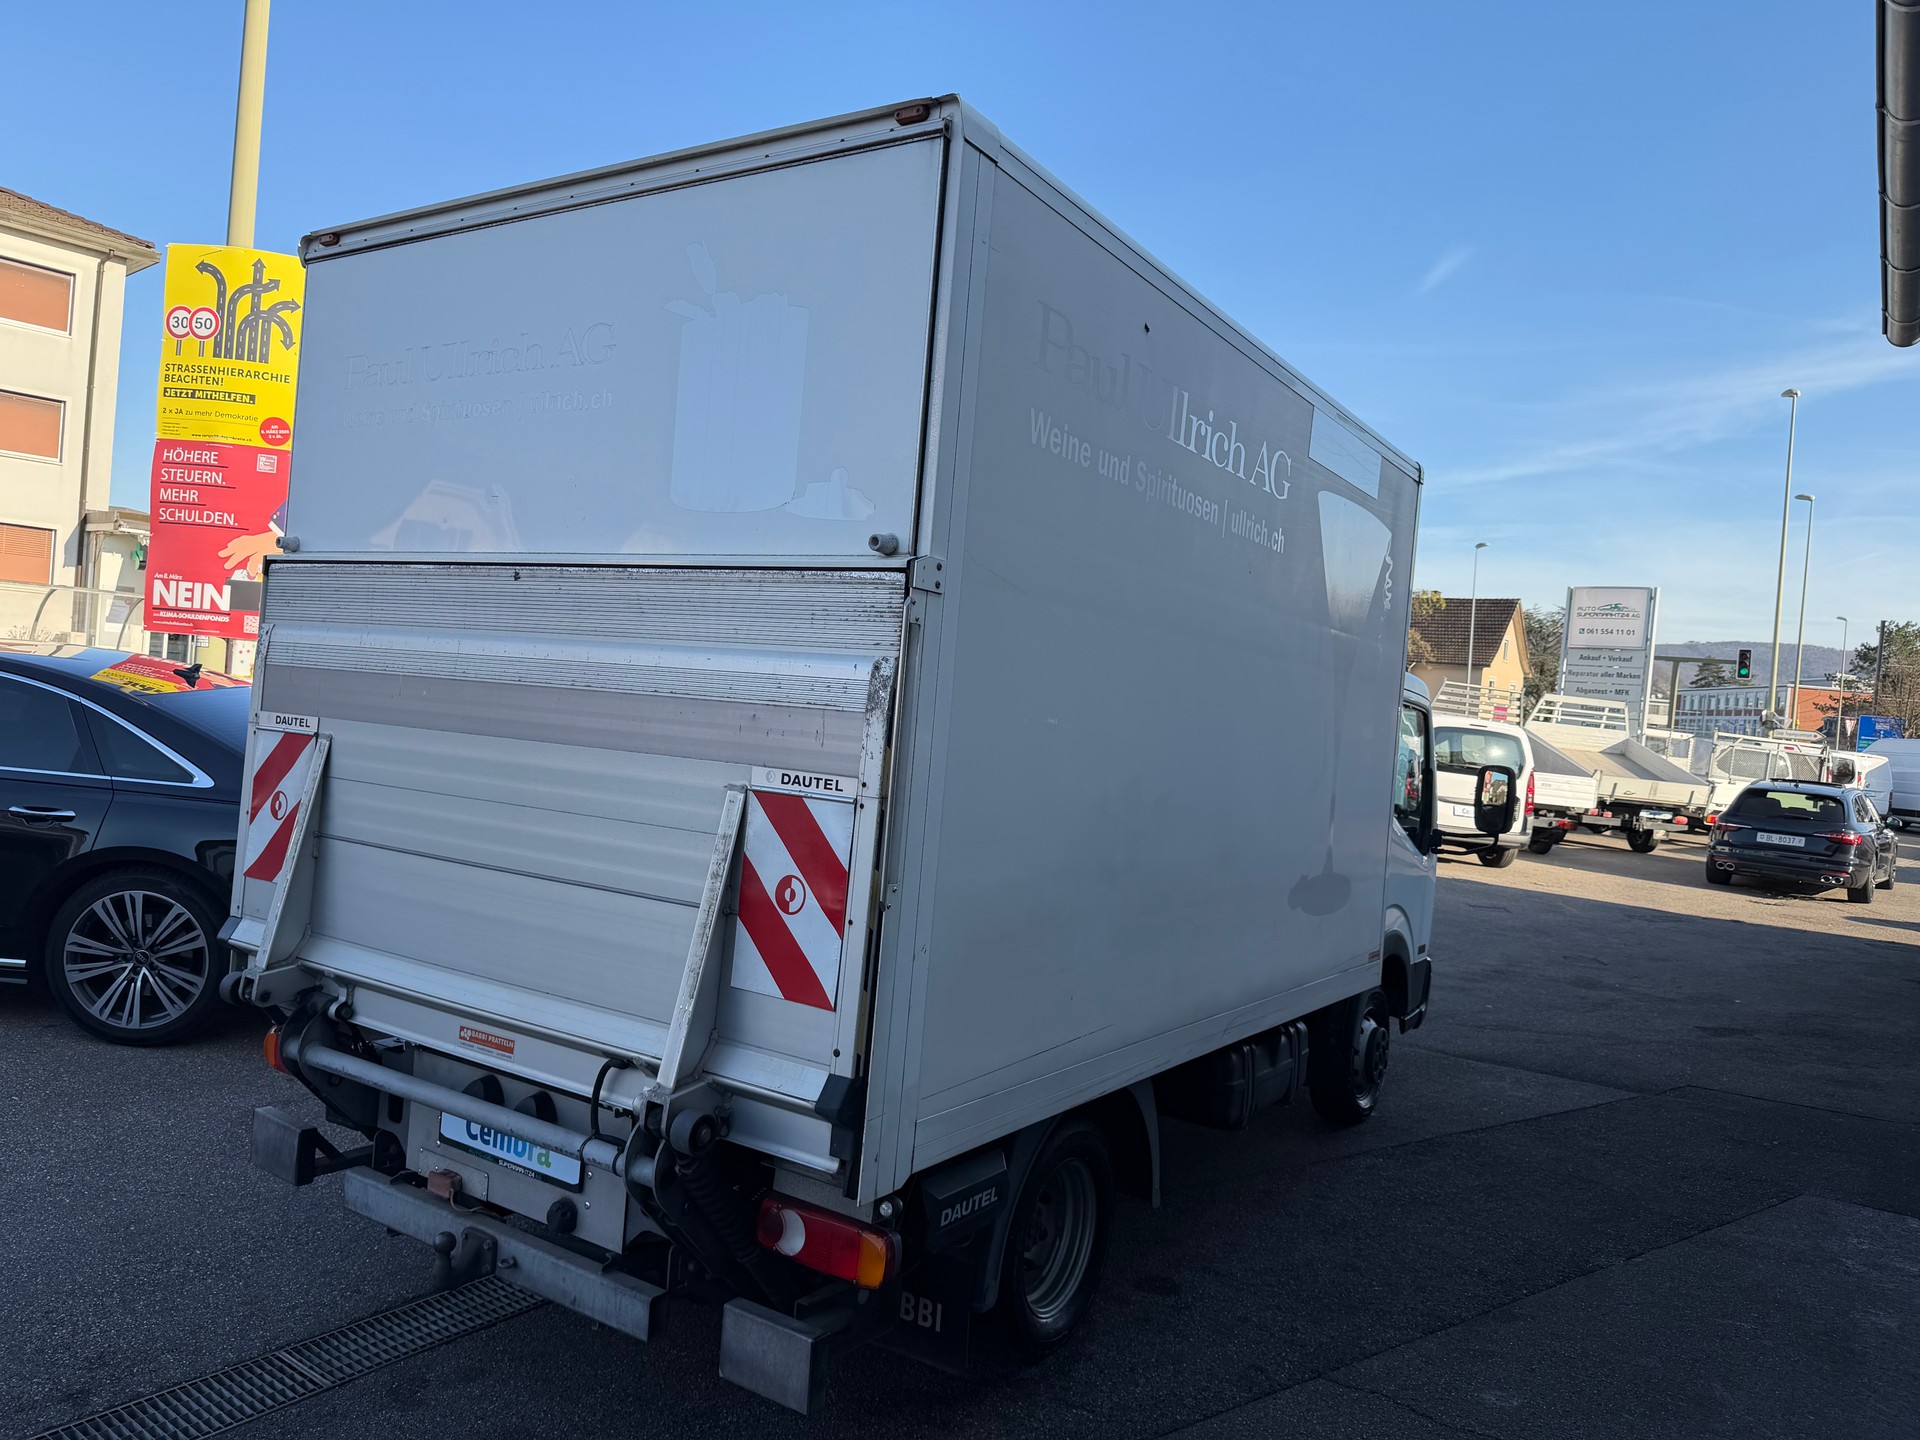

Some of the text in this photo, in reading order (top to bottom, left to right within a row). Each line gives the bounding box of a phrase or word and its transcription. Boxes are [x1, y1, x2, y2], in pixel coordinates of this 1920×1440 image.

[171, 315, 188, 329] 30
[194, 317, 213, 330] 50
[550, 322, 617, 368] AG
[164, 363, 291, 384] STRASSENHIERARCHIE
[164, 373, 224, 387] BEACHTEN!
[164, 388, 254, 404] JETZT MITHELFEN.
[1032, 299, 1292, 500] Paul Ullrich AG
[214, 411, 259, 422] Demokratie
[162, 446, 219, 464] HÖHERE
[160, 467, 226, 485] STEUERN.
[1030, 406, 1092, 468] Weine
[1098, 448, 1131, 486] und
[1135, 460, 1219, 526] Spirituosen
[1231, 508, 1285, 554] ullrich.ch
[159, 487, 198, 502] MEHR
[158, 507, 238, 526] SCHULDEN.
[152, 578, 232, 611] NEIN
[1568, 670, 1599, 678] Reparatur
[1576, 686, 1608, 695] Abgastest
[275, 715, 311, 728] DAUTEL
[780, 772, 844, 792] DAUTEL
[939, 1186, 998, 1227] DAUTEL
